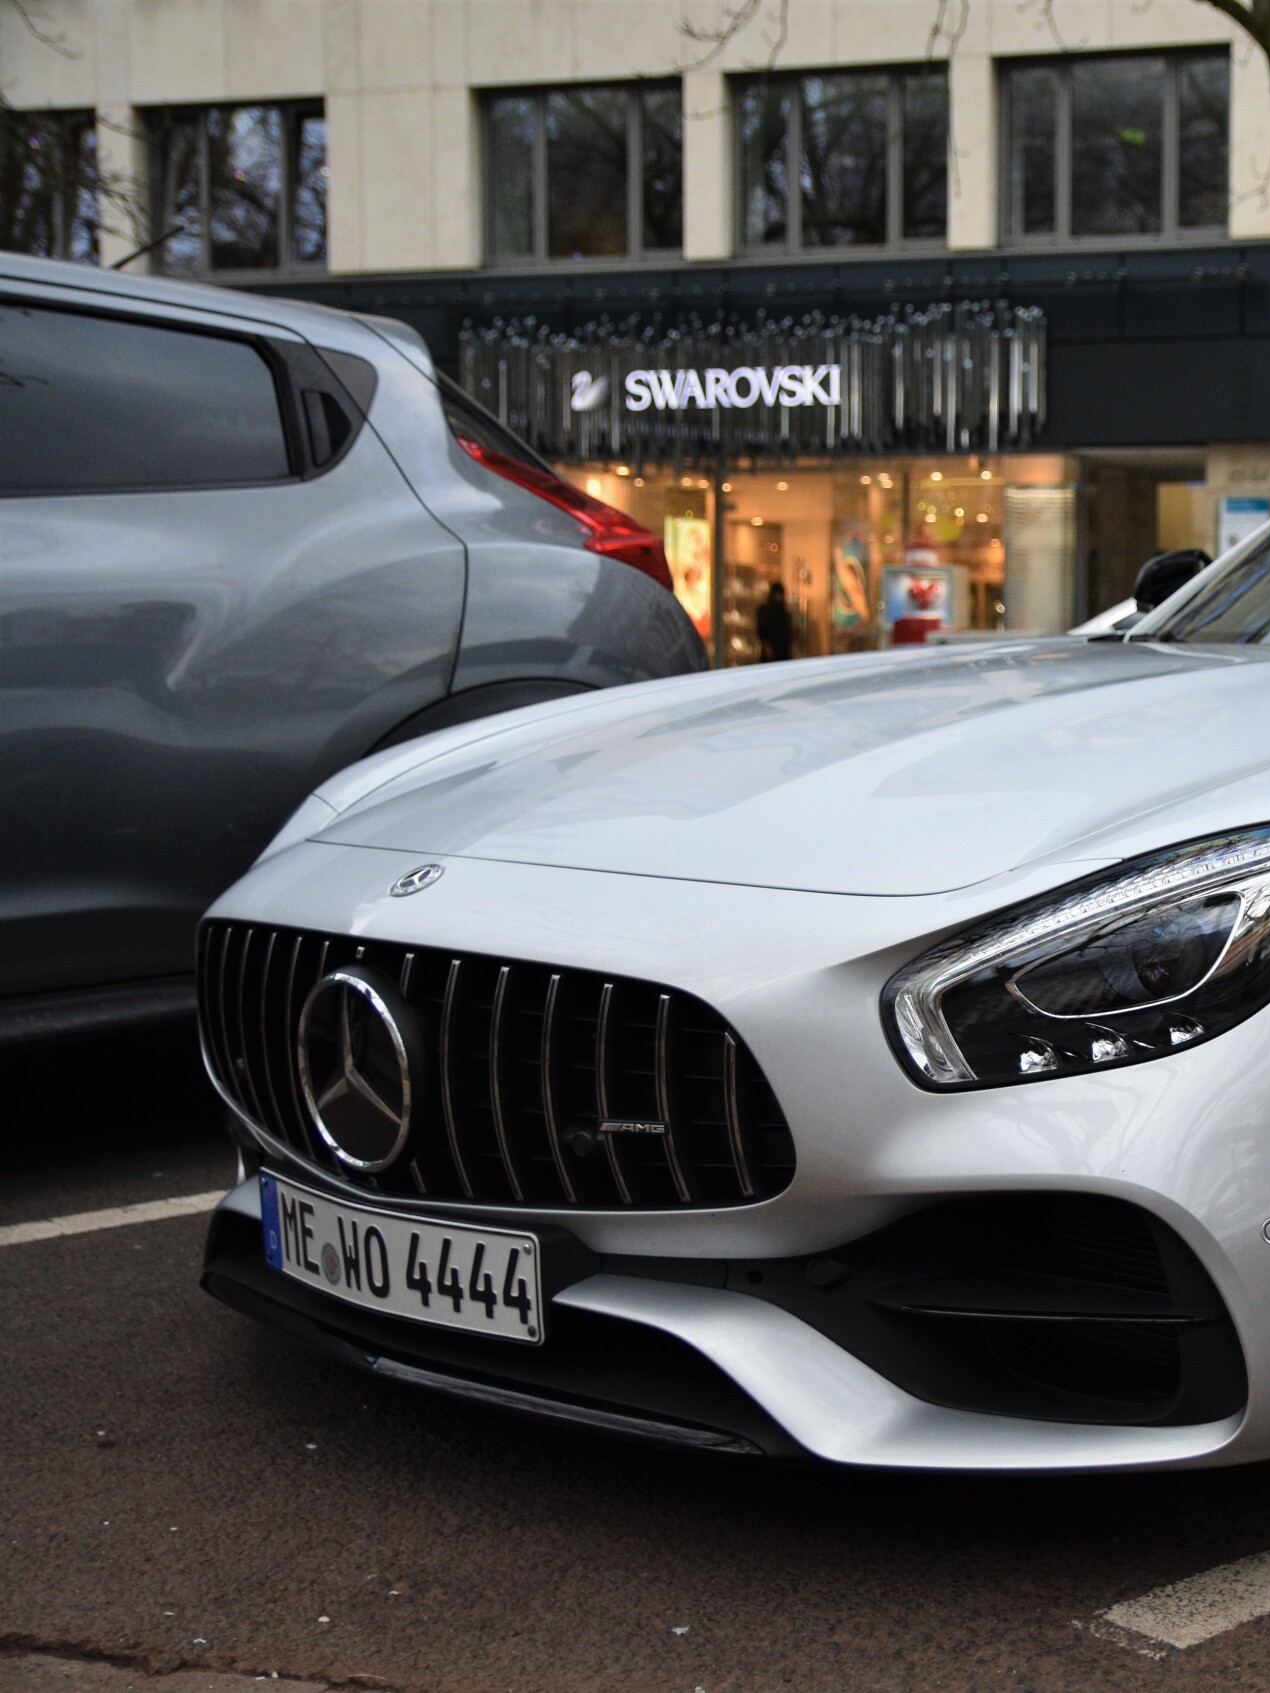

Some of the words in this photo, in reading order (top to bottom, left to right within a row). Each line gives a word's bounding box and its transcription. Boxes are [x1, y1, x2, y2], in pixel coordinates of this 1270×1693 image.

[625, 364, 842, 412] SWAROVSKI
[619, 1123, 665, 1133] AMG
[269, 1230, 278, 1250] D
[280, 1192, 320, 1275] ME
[337, 1216, 391, 1298] WO
[406, 1232, 533, 1325] 4444
